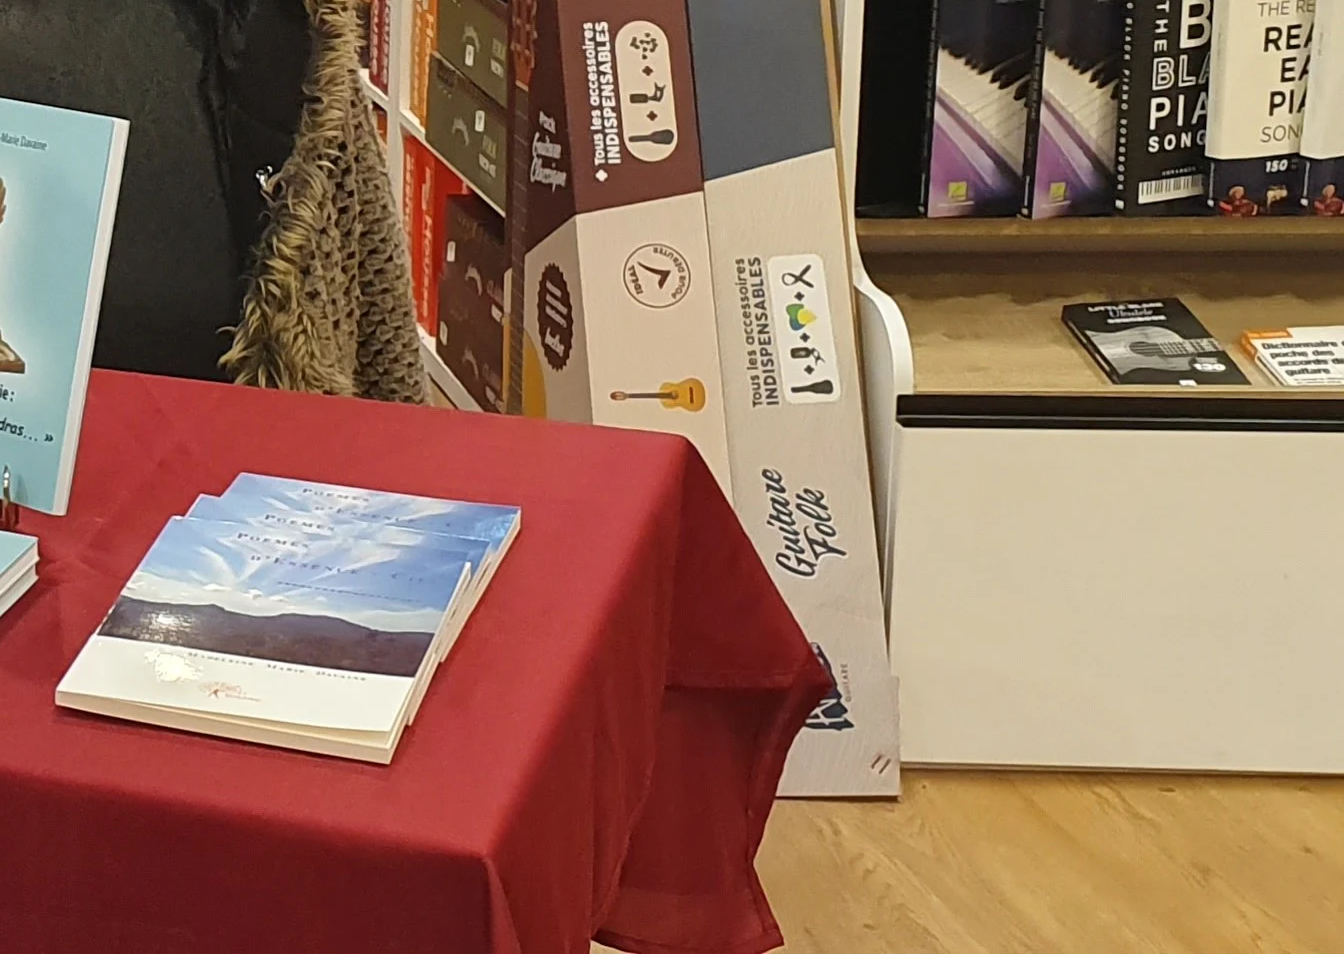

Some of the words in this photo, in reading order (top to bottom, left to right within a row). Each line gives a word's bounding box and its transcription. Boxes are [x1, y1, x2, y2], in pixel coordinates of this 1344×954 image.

[1258, 0, 1290, 17] THE
[1154, 0, 1170, 52] THE
[1263, 25, 1314, 53] REA
[582, 22, 600, 106] accessoires
[1151, 55, 1211, 92] BLA
[1280, 56, 1311, 83] EA
[595, 20, 621, 165] INDISPENSABLES
[1268, 90, 1308, 117] PIA
[589, 109, 603, 130] les
[1148, 96, 1209, 131] PIA
[1148, 130, 1207, 154] SONG
[1261, 125, 1303, 145] SON
[590, 133, 607, 166] Tous
[1265, 159, 1288, 173] 150
[671, 275, 687, 300] POUR
[733, 258, 756, 345] accessoires
[747, 256, 780, 407] INDISPENSABLES
[1261, 340, 1338, 351] Dictionnaire
[1269, 348, 1309, 359] poche
[1312, 348, 1335, 357] des
[744, 349, 759, 371] les
[1285, 367, 1330, 377] guitare
[749, 375, 763, 409] Tous
[761, 468, 821, 577] Guitare
[790, 489, 848, 561] Folk
